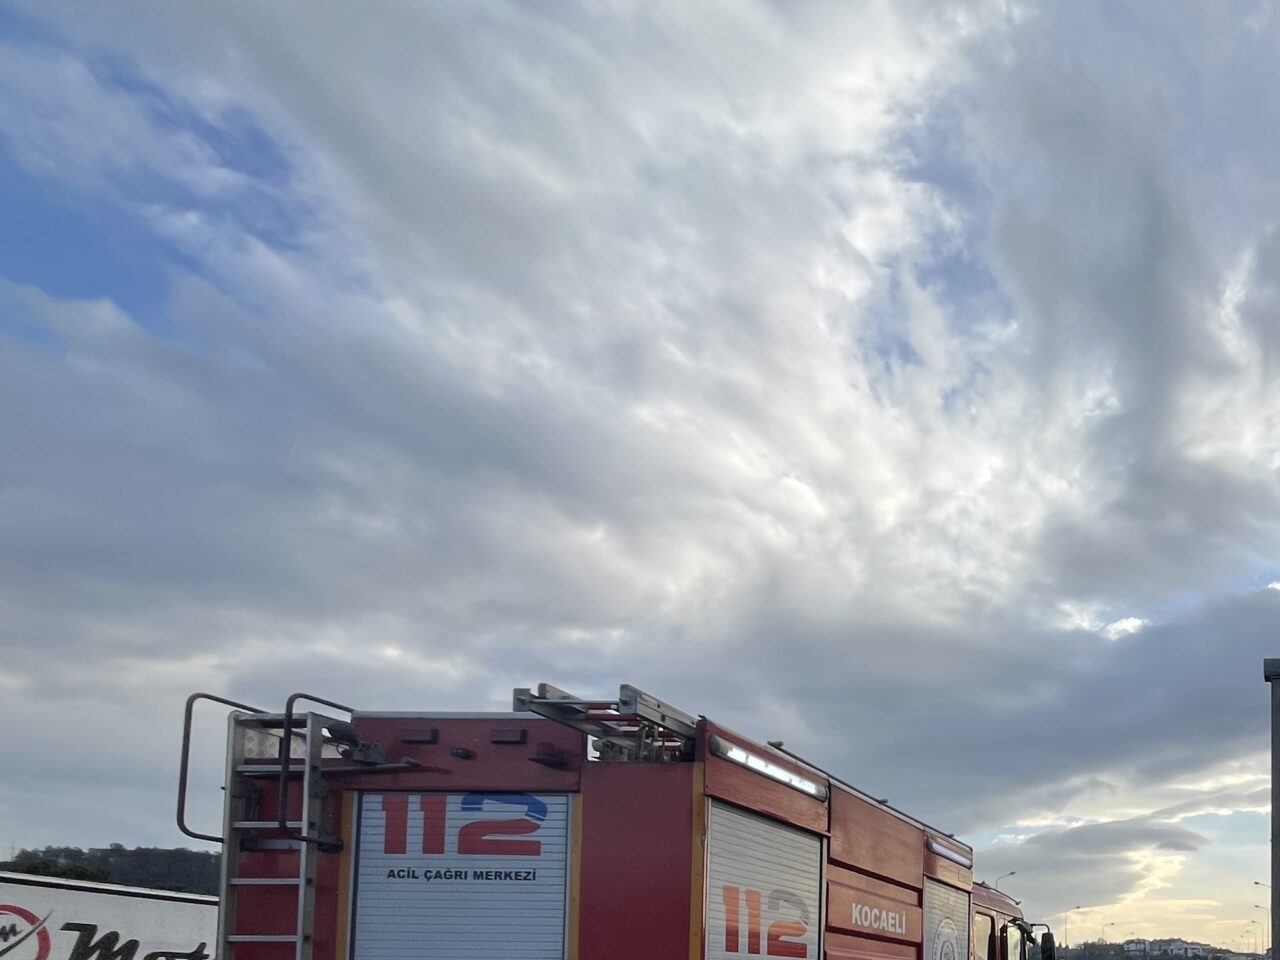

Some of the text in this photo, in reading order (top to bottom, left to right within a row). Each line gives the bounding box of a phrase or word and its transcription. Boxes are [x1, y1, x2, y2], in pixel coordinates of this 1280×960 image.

[382, 792, 548, 856] 112
[387, 867, 537, 882] ACİL ÇAĞRI MERKEZİ
[722, 885, 810, 959] 112
[851, 902, 906, 934] KOCAELİ
